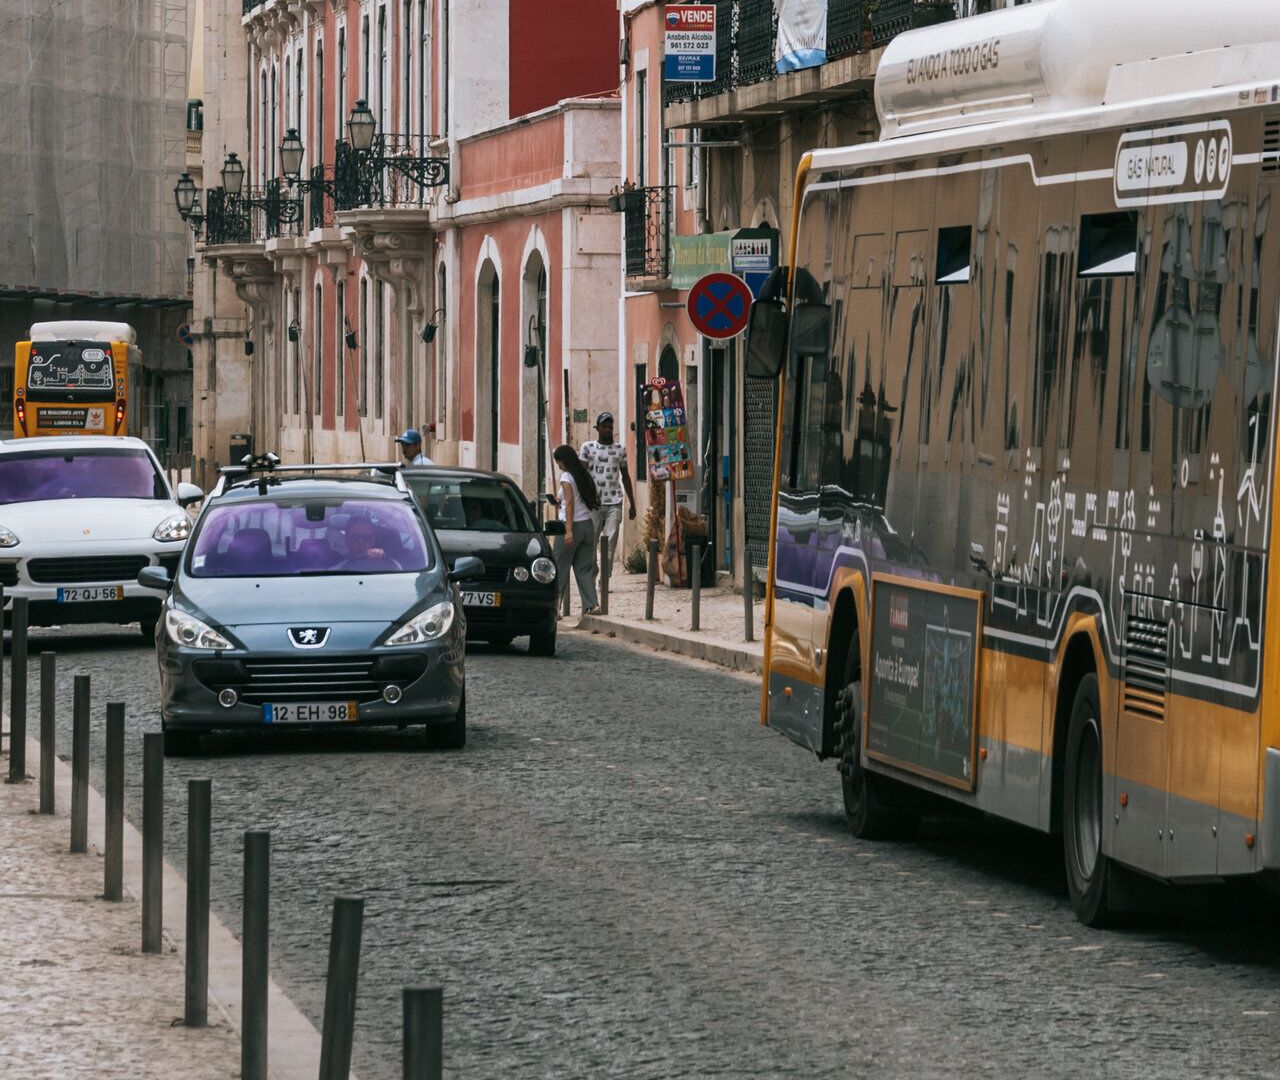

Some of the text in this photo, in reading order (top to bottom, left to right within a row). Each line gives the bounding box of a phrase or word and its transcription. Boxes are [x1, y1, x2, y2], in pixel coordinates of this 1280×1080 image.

[681, 10, 713, 23] VENDE
[667, 33, 713, 41] Anabela Alcobia
[907, 58, 919, 85] EU
[918, 52, 941, 82] ANDO
[949, 46, 972, 77] TODO
[980, 37, 1000, 71] GÁS
[1128, 153, 1176, 180] GÁS NATURAL
